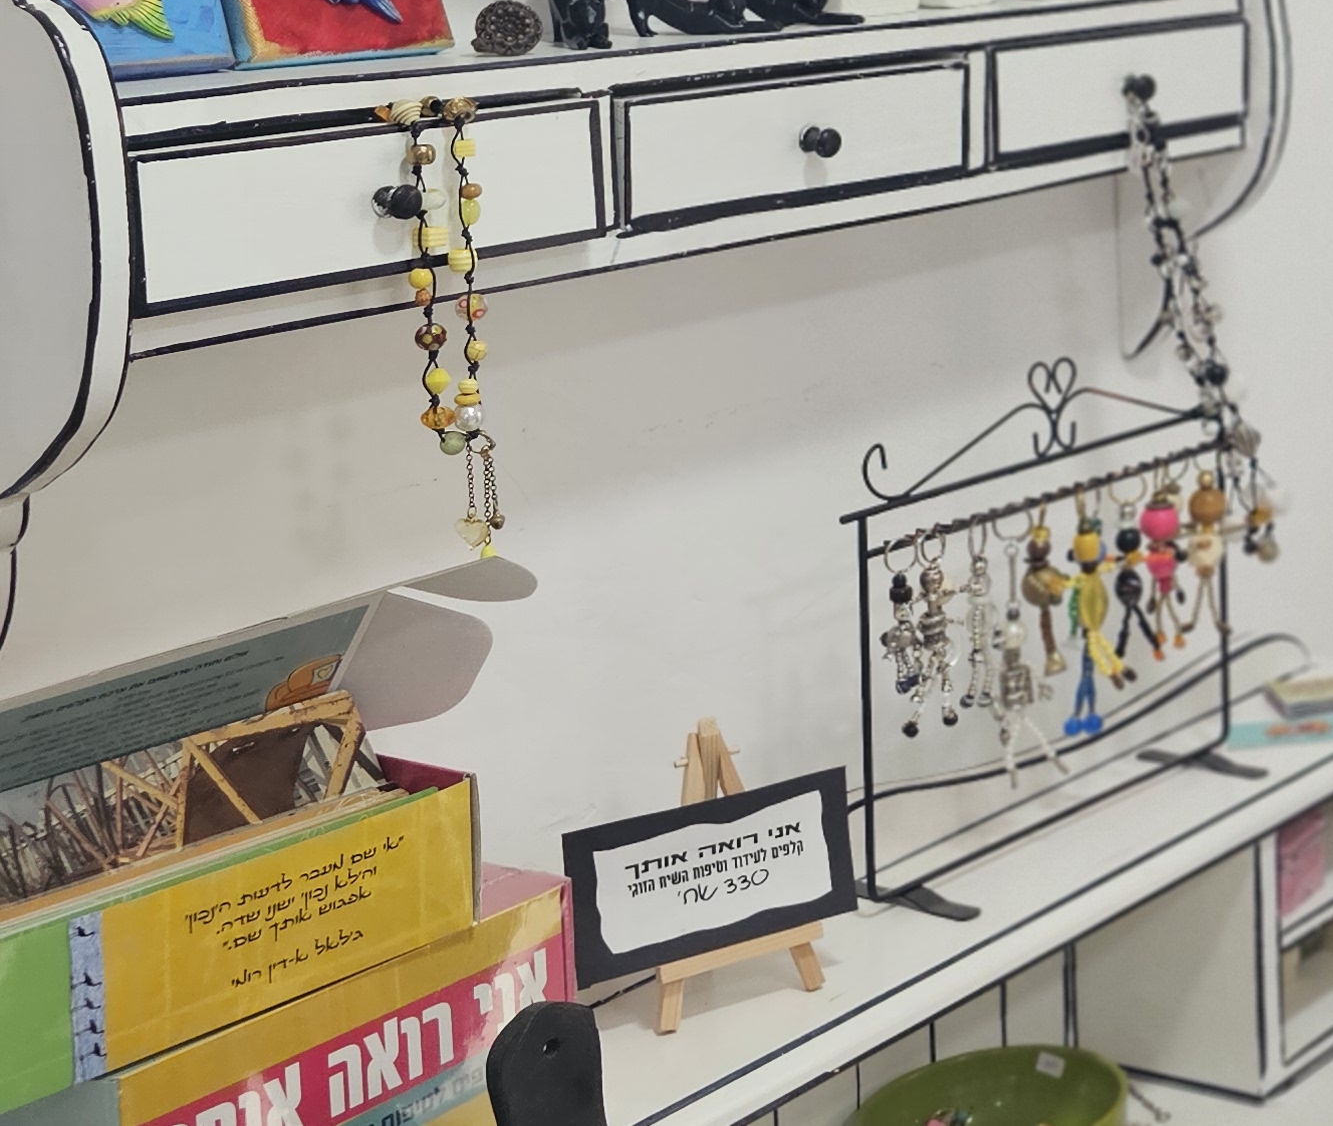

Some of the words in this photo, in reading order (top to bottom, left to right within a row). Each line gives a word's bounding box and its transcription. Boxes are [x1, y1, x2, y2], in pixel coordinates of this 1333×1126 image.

[768, 822, 801, 839] אני
[350, 847, 376, 864] שם
[698, 833, 759, 858] רואה
[732, 847, 767, 869] לעידוד
[771, 839, 804, 859] קלפים
[300, 853, 344, 881] מעבר
[625, 851, 688, 880] אותך
[693, 859, 728, 880] וטיפוח
[237, 873, 293, 906] לדעות
[627, 878, 656, 898] הזוגי
[659, 870, 690, 888] השיח
[724, 868, 770, 894] 330
[265, 897, 295, 922] ישנו
[318, 886, 372, 916] אפגוש
[216, 909, 261, 935] שדה.
[269, 908, 312, 942] אותך
[231, 968, 262, 989] רומי
[327, 1001, 455, 1119] רואה
